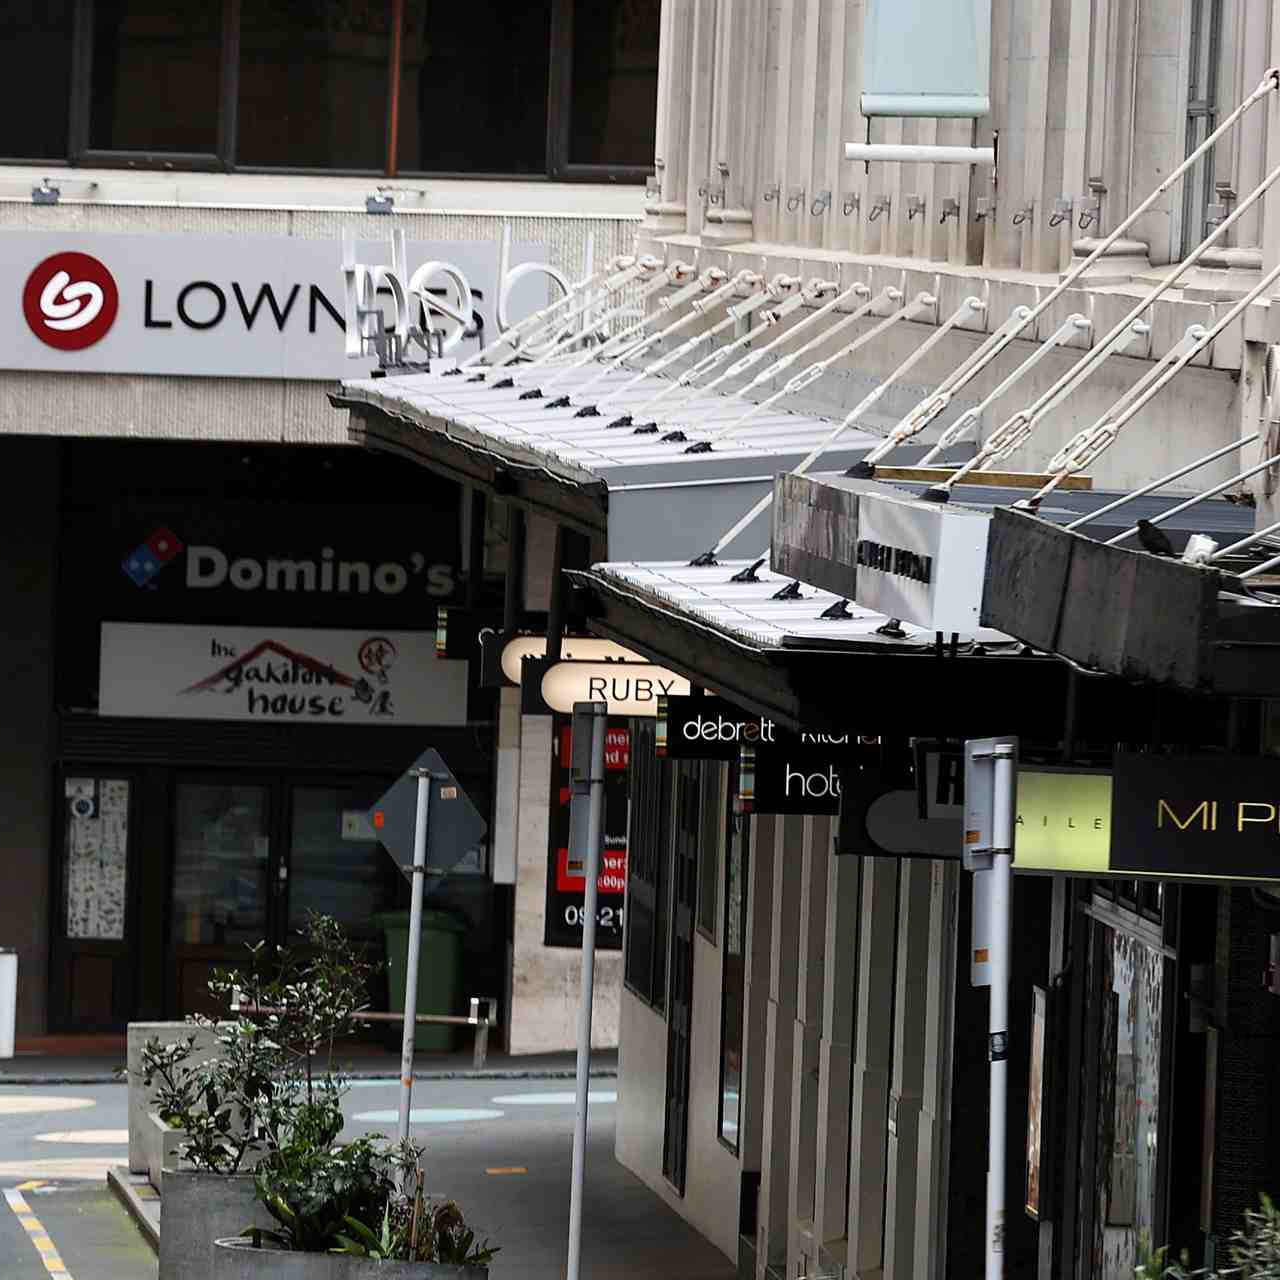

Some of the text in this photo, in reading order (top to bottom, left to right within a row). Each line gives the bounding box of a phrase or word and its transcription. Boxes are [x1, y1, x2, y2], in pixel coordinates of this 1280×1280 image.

[185, 546, 455, 596] Domino's
[247, 687, 344, 716] house
[589, 677, 676, 702] RUBY
[683, 714, 775, 742] debrett
[1157, 799, 1217, 831] MI
